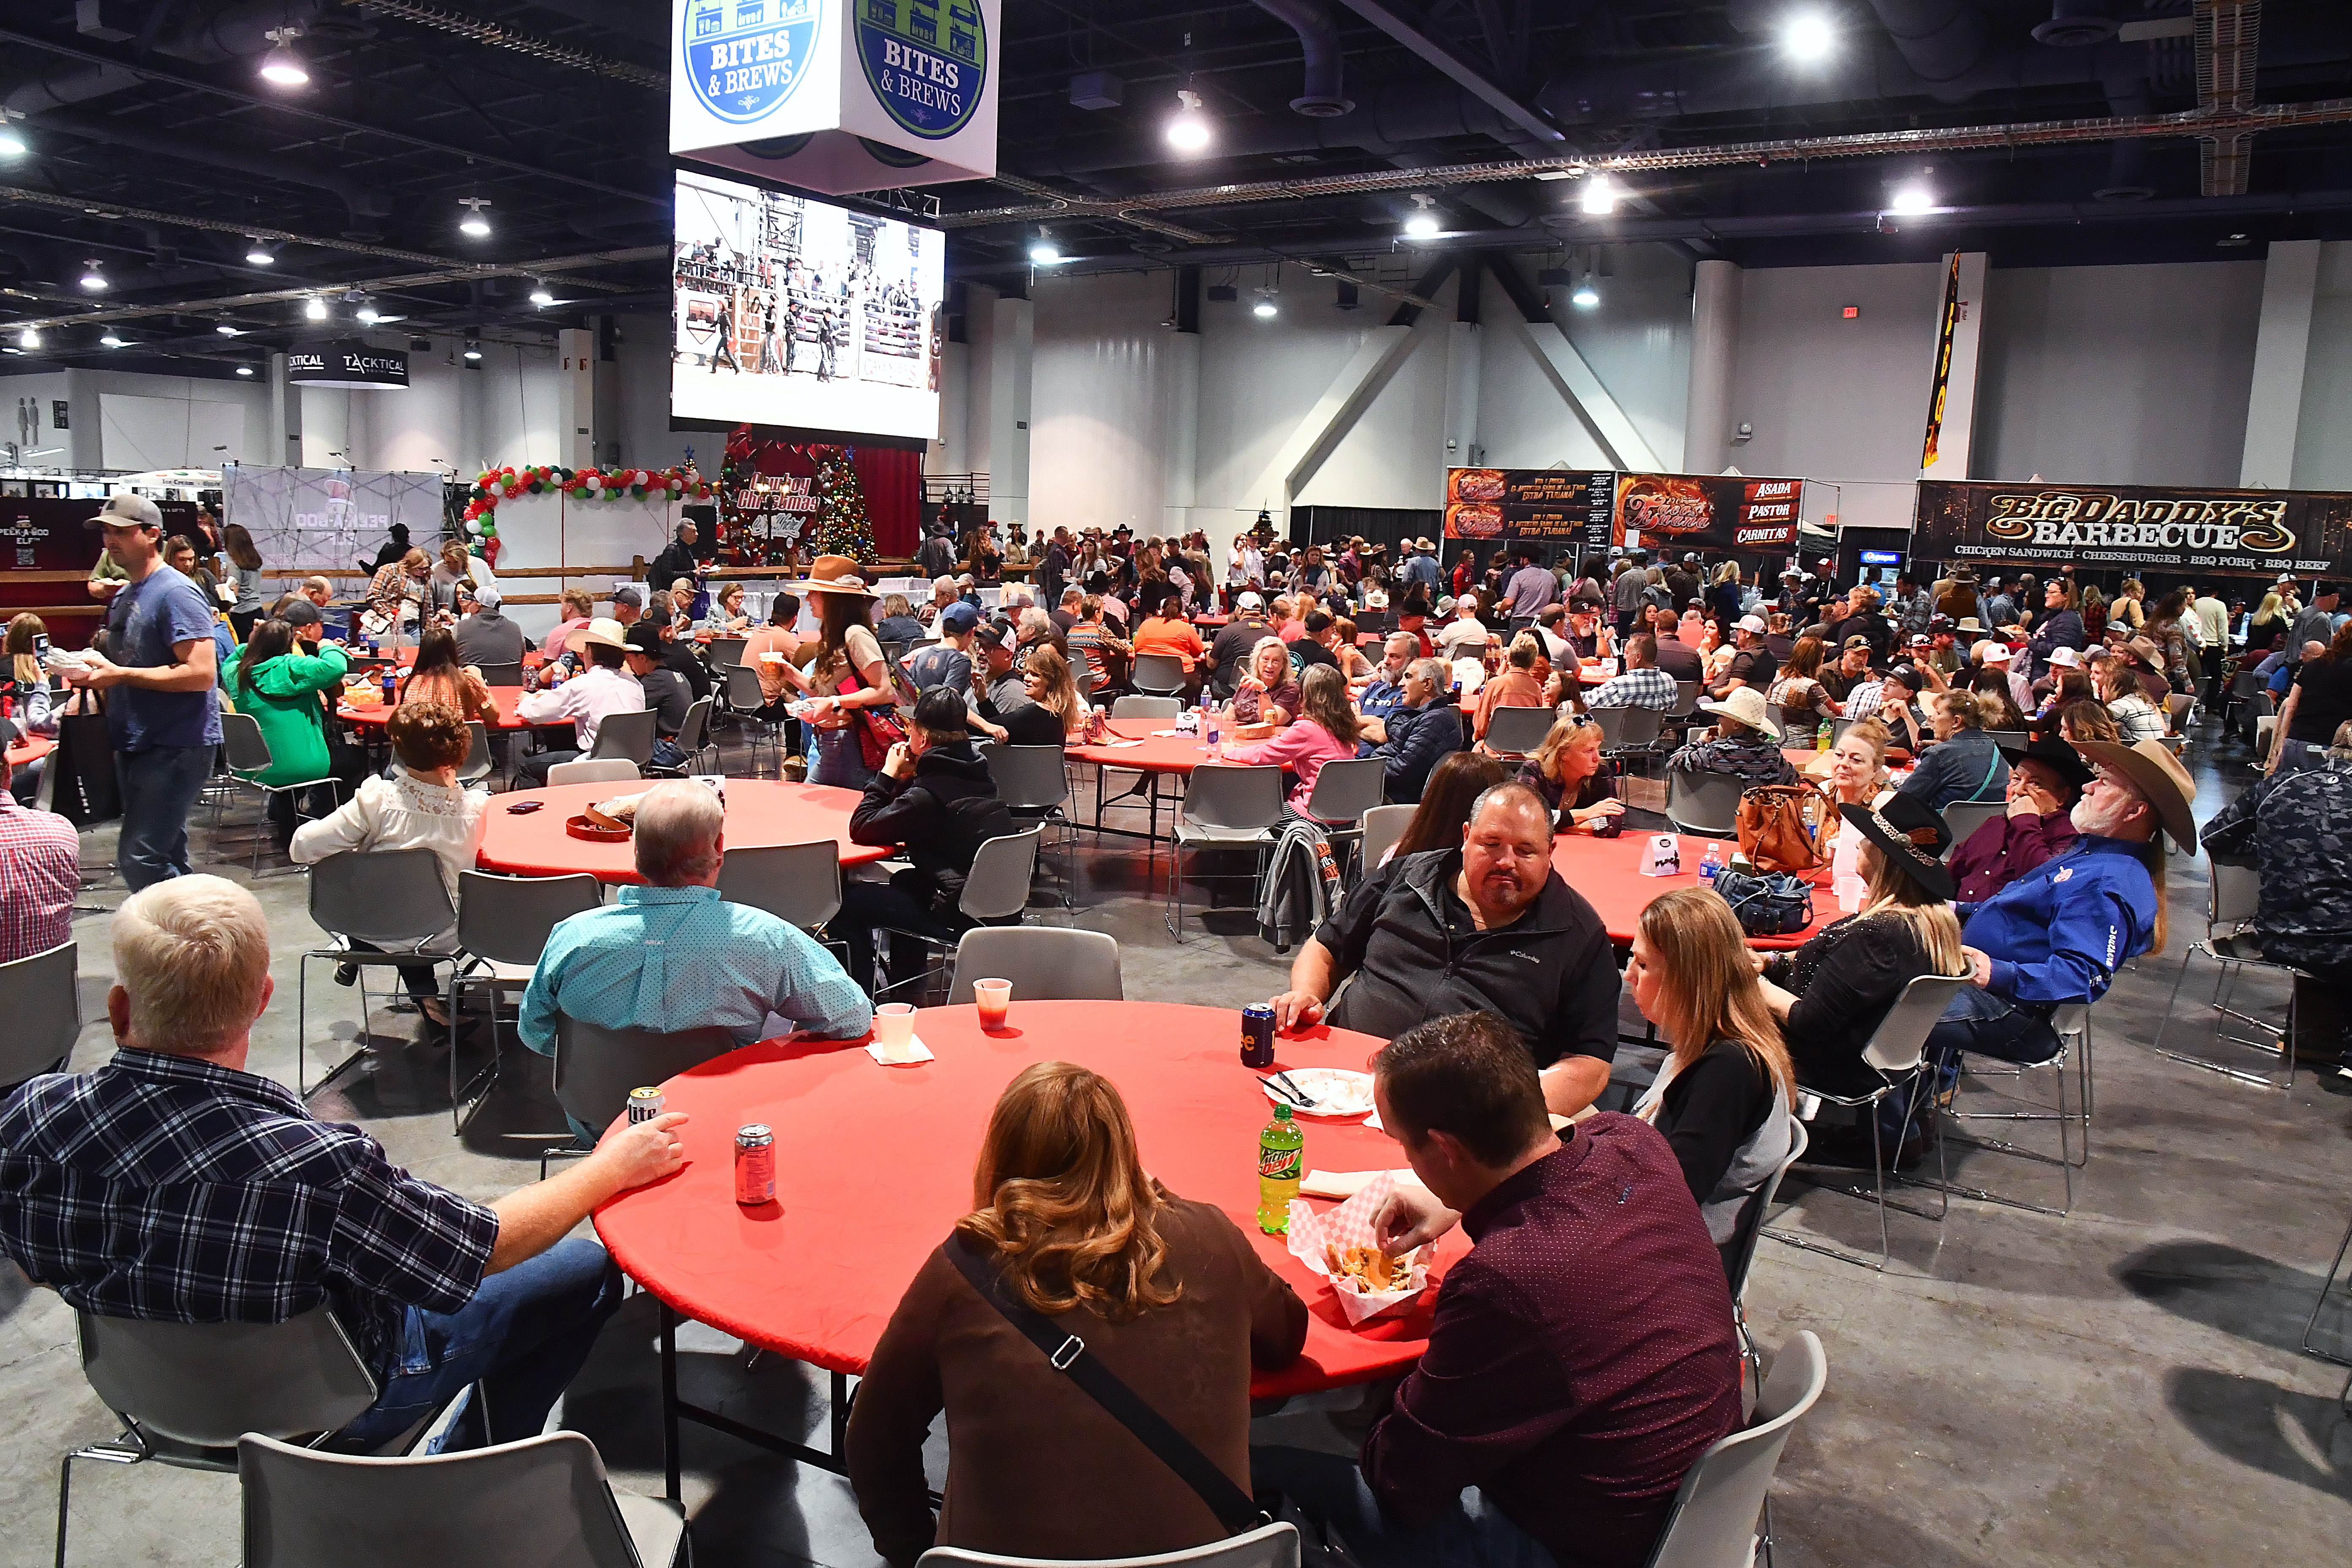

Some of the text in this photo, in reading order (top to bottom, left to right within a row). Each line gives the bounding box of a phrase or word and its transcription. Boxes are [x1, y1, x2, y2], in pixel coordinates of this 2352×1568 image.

[711, 30, 790, 71] BITES
[884, 38, 959, 89] BITES
[708, 59, 793, 98] & BREWS
[881, 69, 961, 117] & BREWS
[343, 353, 404, 374] TACKTICAL
[1754, 482, 1791, 497] ASADA
[1748, 504, 1790, 519] PASTOR
[1737, 528, 1788, 543] CARNITAS
[2031, 521, 2240, 550] BARBECUE
[1955, 545, 2007, 558] CHICKEN
[2008, 547, 2074, 559] SANDWICH
[2082, 550, 2181, 564] CHEESEBURGER
[2189, 555, 2217, 566] BBQ
[2218, 557, 2256, 570] PORK
[2264, 559, 2292, 570] BBQ
[2295, 560, 2331, 570] BEEF
[1515, 951, 1541, 964] Columbia
[629, 1103, 656, 1124] Lite
